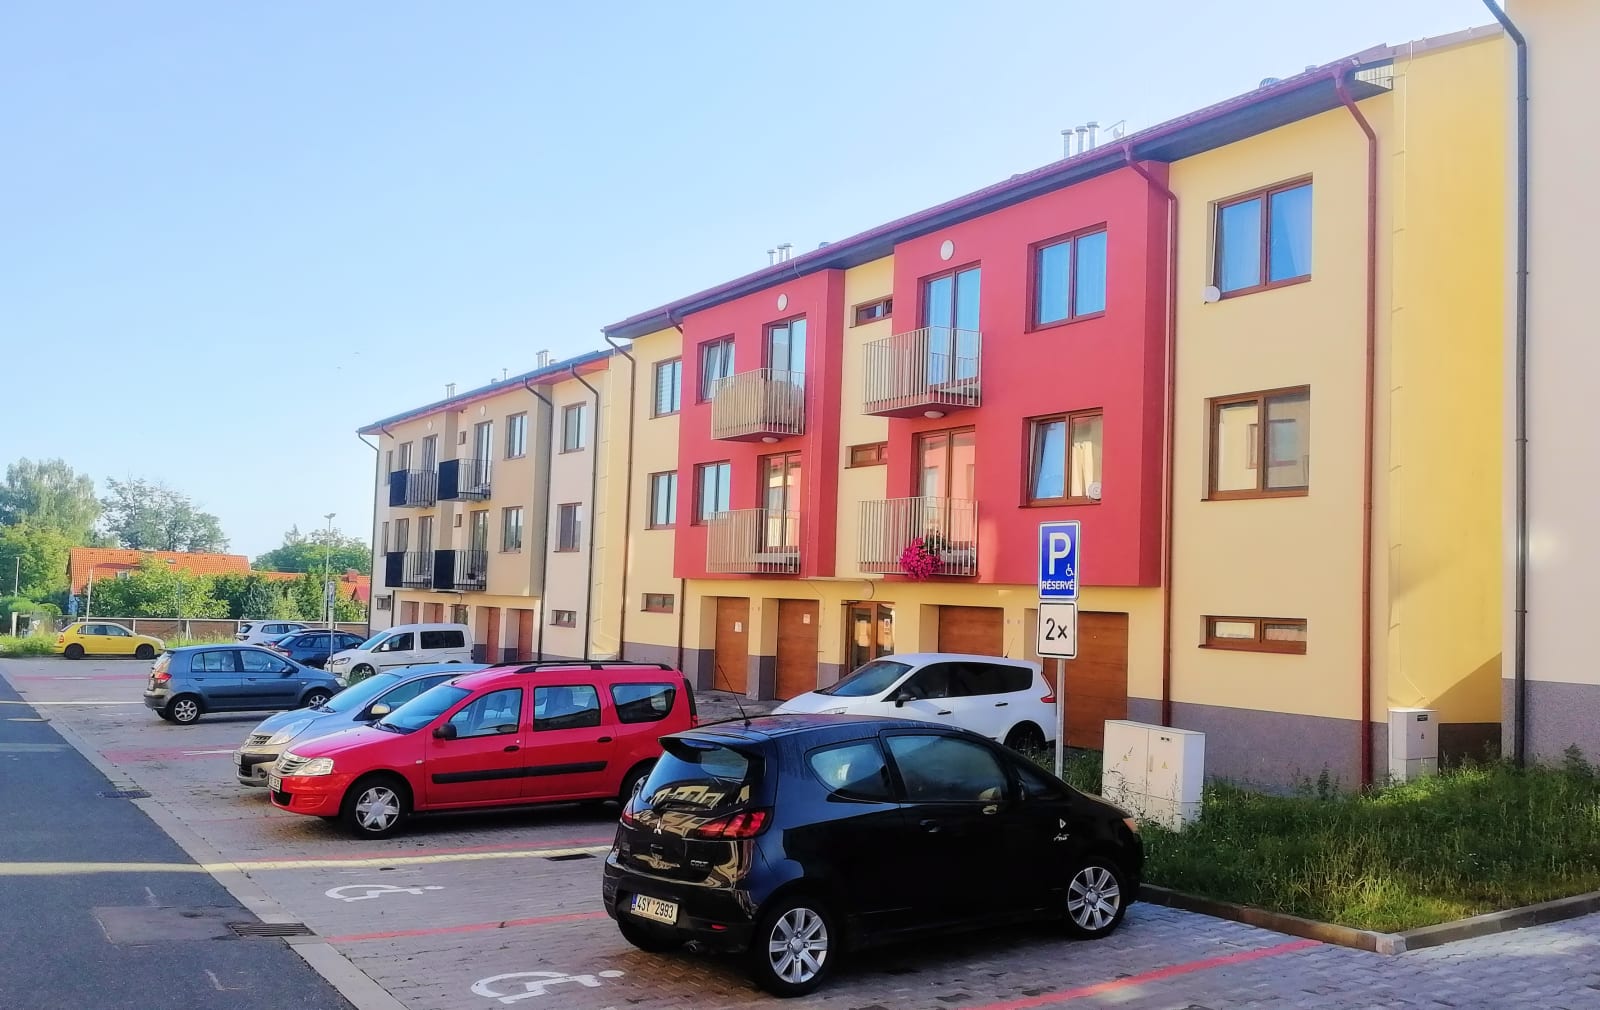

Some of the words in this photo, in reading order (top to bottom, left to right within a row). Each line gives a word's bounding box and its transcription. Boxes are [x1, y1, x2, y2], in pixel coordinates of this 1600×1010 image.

[1049, 532, 1072, 575] P
[1042, 579, 1075, 590] RÉSERVÉ
[637, 896, 651, 912] 4SY
[654, 901, 674, 919] 2993
